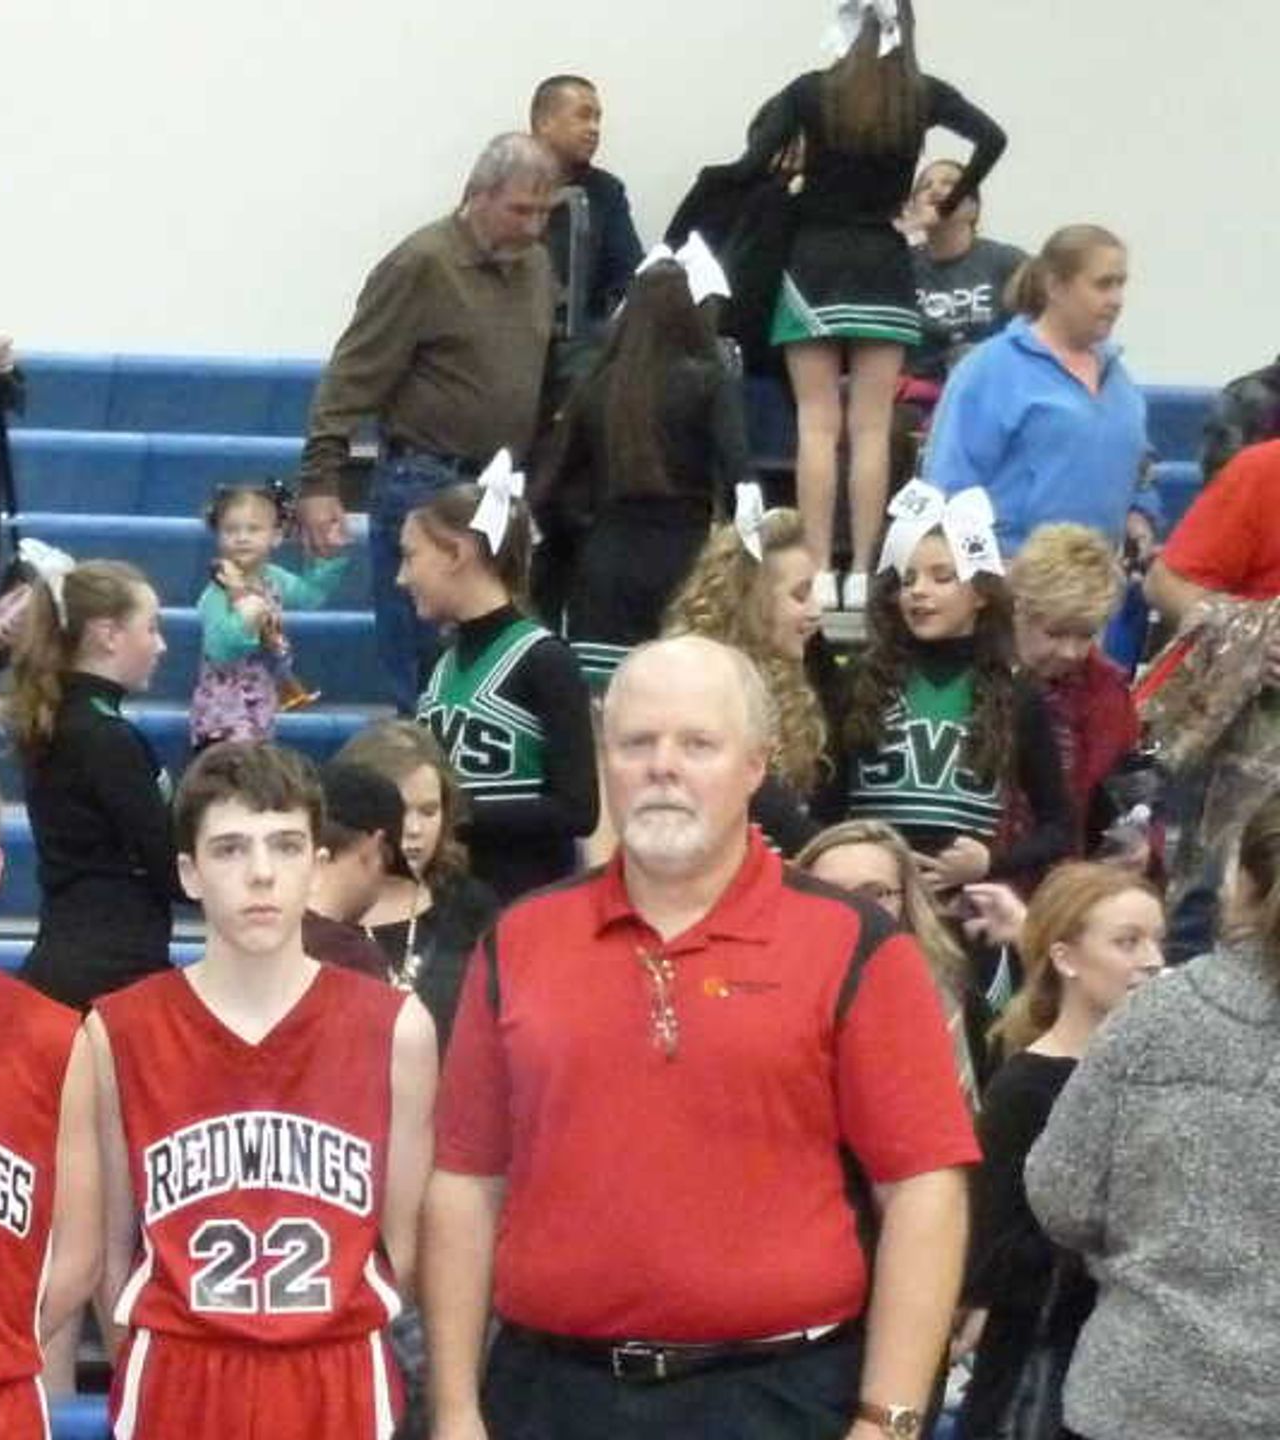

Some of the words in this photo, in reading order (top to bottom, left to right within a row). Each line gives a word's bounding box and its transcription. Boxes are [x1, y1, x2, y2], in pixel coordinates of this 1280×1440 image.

[417, 704, 516, 778] VS
[144, 1110, 372, 1225] REDWINGS
[188, 1217, 332, 1314] 22
